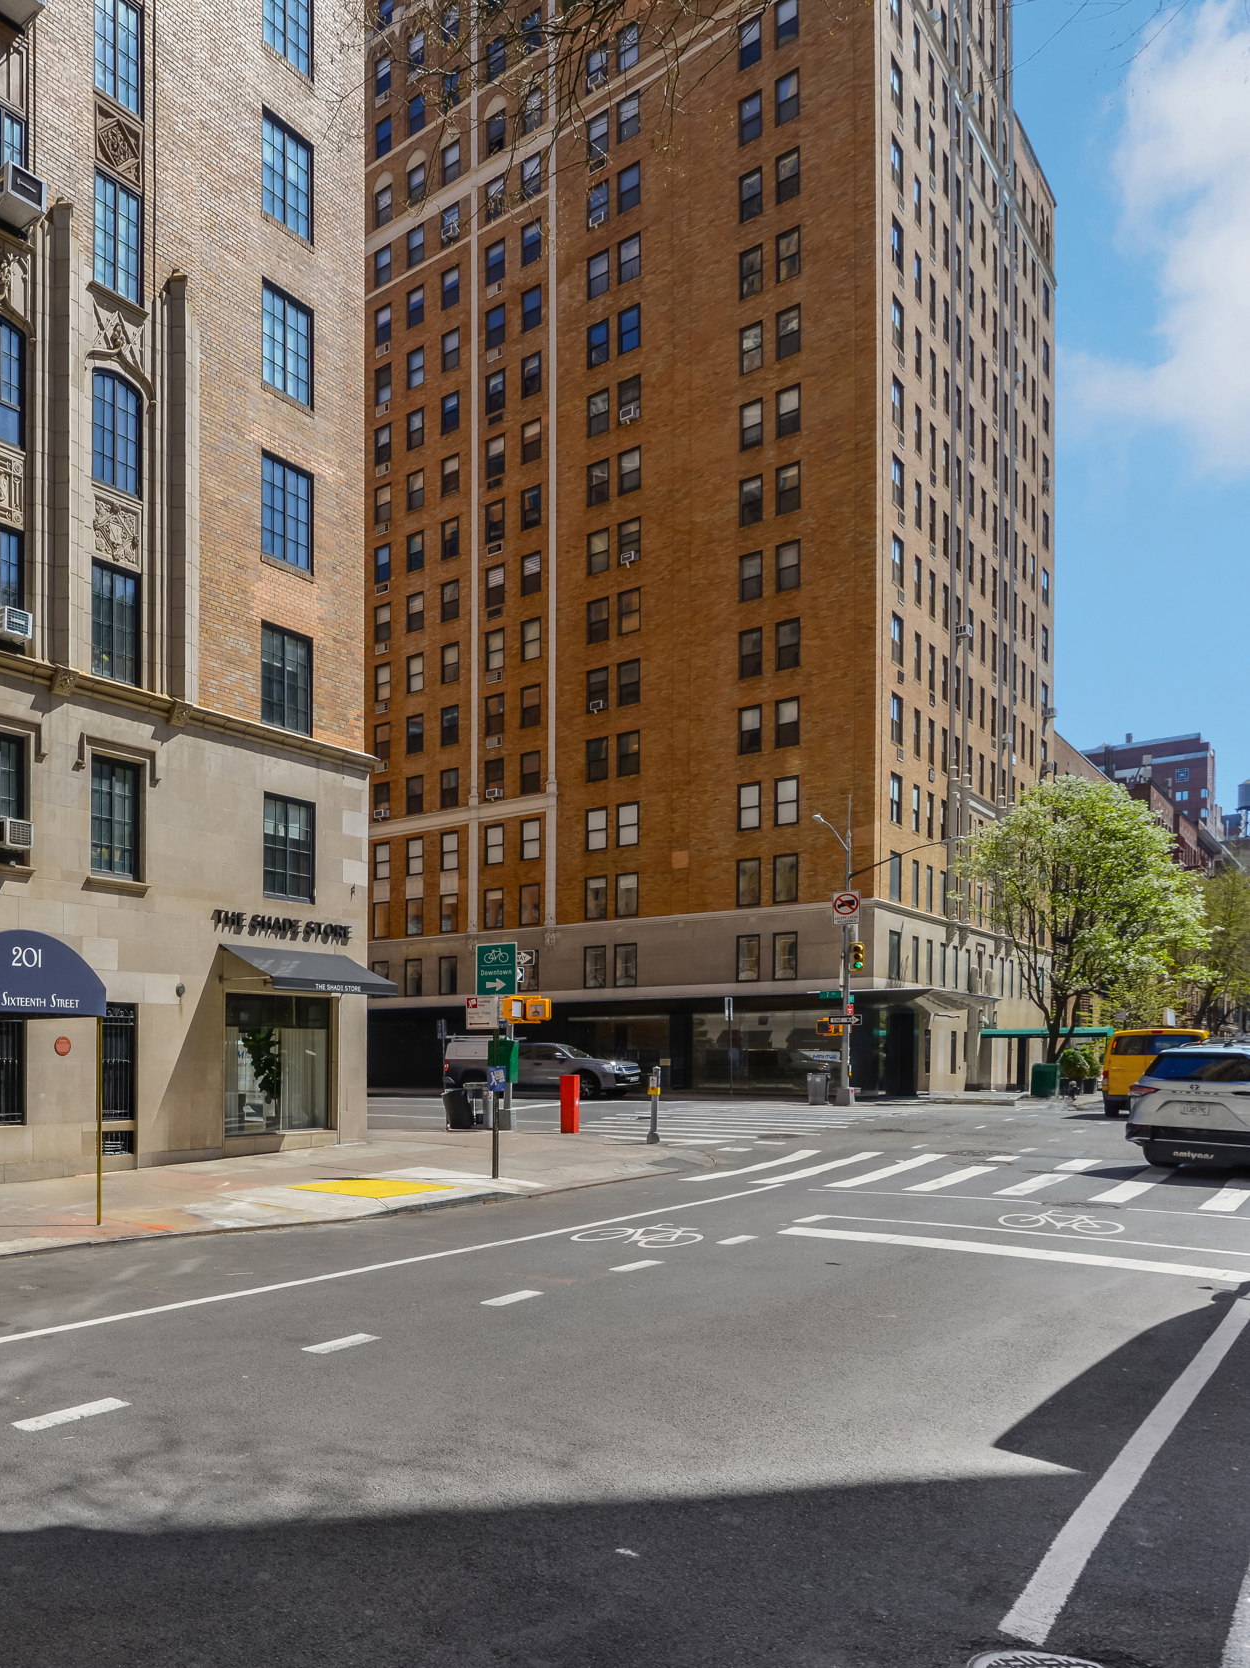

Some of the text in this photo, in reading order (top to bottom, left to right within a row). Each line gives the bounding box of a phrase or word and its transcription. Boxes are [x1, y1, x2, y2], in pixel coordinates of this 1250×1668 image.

[214, 909, 352, 939] THE SHADE STORE
[11, 946, 42, 968] 201
